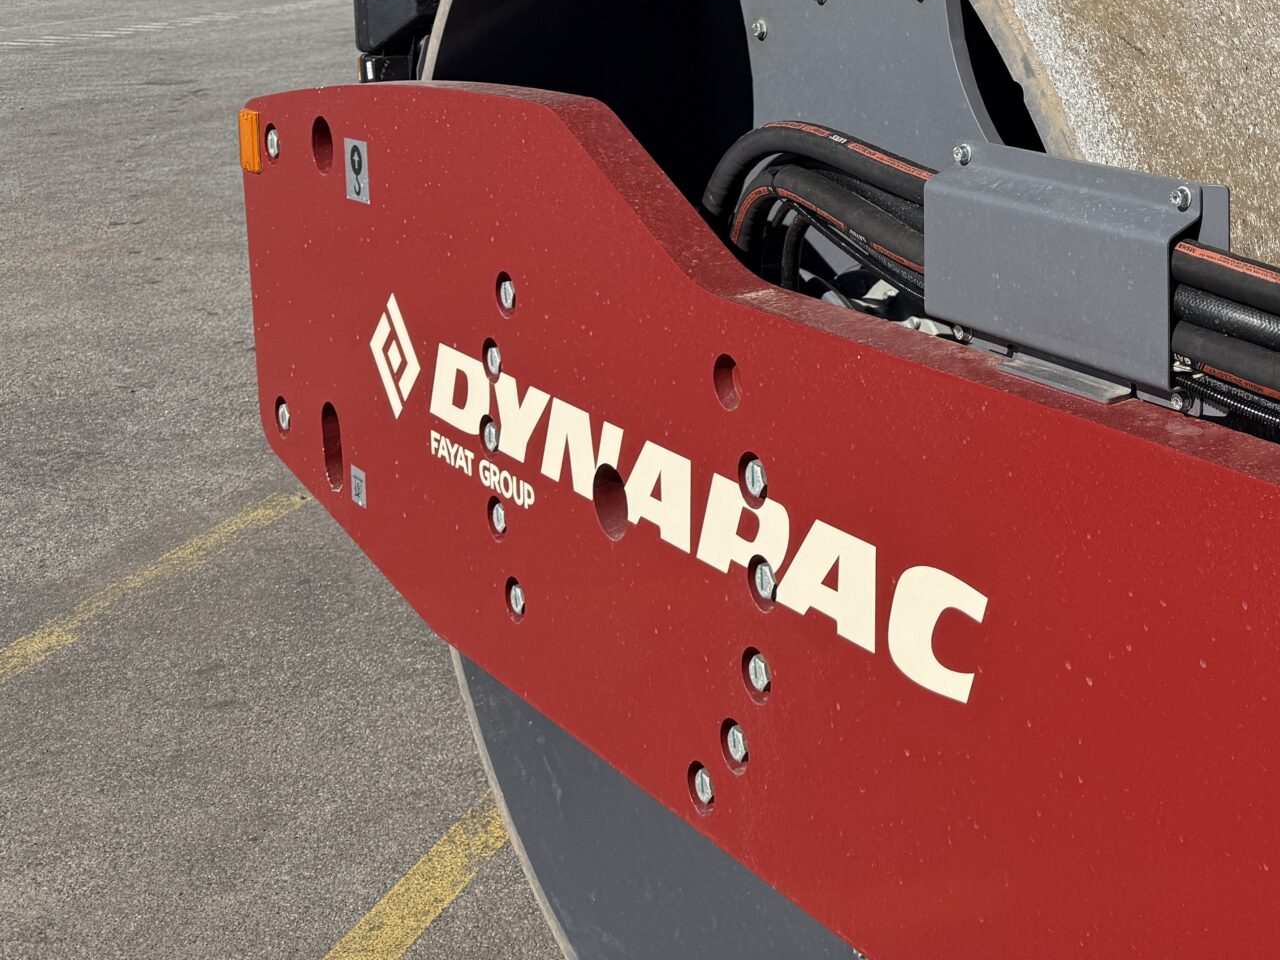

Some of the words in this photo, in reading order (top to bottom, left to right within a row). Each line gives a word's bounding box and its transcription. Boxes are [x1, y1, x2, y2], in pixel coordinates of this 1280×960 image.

[430, 430, 473, 477] FAYAT
[479, 459, 535, 509] GROUP
[430, 343, 988, 704] DYNAPAC
